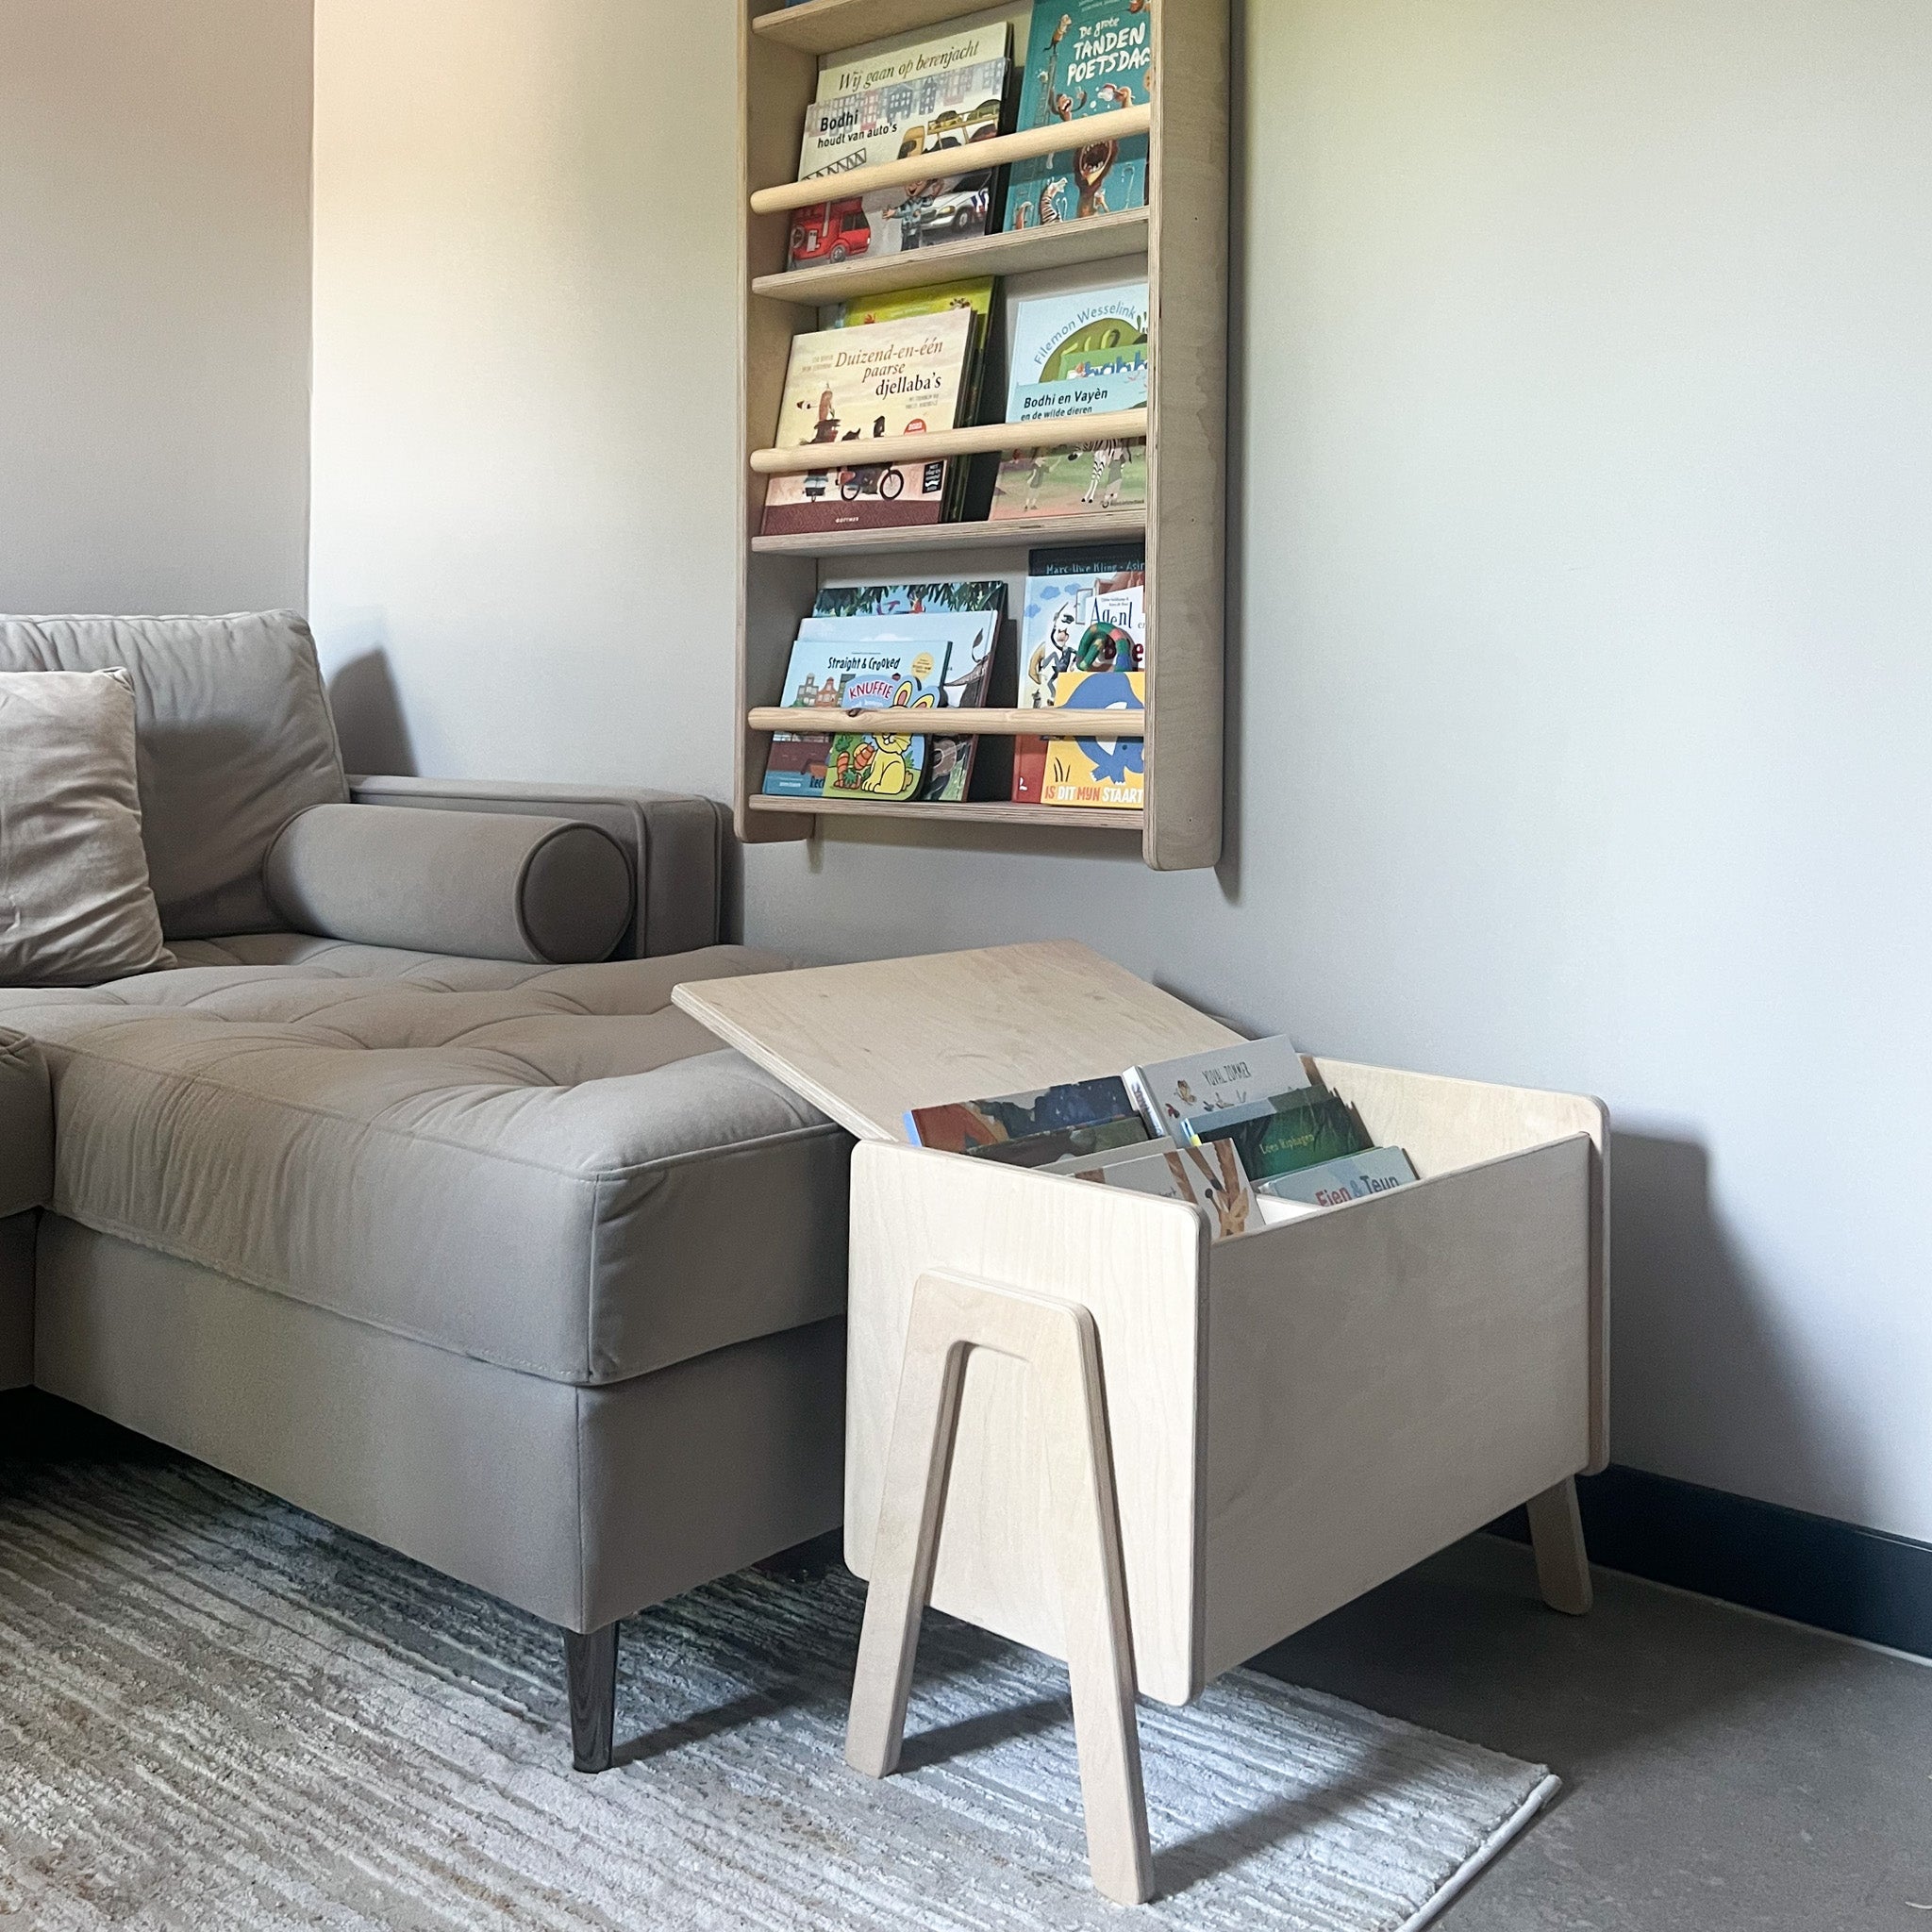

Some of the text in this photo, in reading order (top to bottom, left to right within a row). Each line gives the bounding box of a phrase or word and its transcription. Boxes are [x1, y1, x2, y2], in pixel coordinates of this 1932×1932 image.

[1073, 22, 1146, 60] TANDEN
[1079, 26, 1092, 39] De
[839, 41, 980, 92] Wij gaan op berenjacht
[1067, 47, 1151, 86] POETSDAG
[820, 109, 859, 132] Bodhi
[817, 123, 898, 148] houdt van auto's
[1034, 301, 1138, 365] Filemon Wesselink
[834, 337, 944, 367] Duizend-en-één
[862, 363, 906, 383] paarse
[875, 372, 941, 400] djellaba's
[1024, 388, 1108, 408] Bodhi en Vayèn
[1021, 406, 1092, 422] en de wilde dieren
[827, 657, 860, 671] Straight
[861, 658, 867, 669] &
[869, 657, 901, 671] Crooked
[849, 681, 894, 699] KNUFFIE
[1045, 785, 1056, 799] IS
[1058, 786, 1076, 801] DIT
[1103, 788, 1144, 803] STAART
